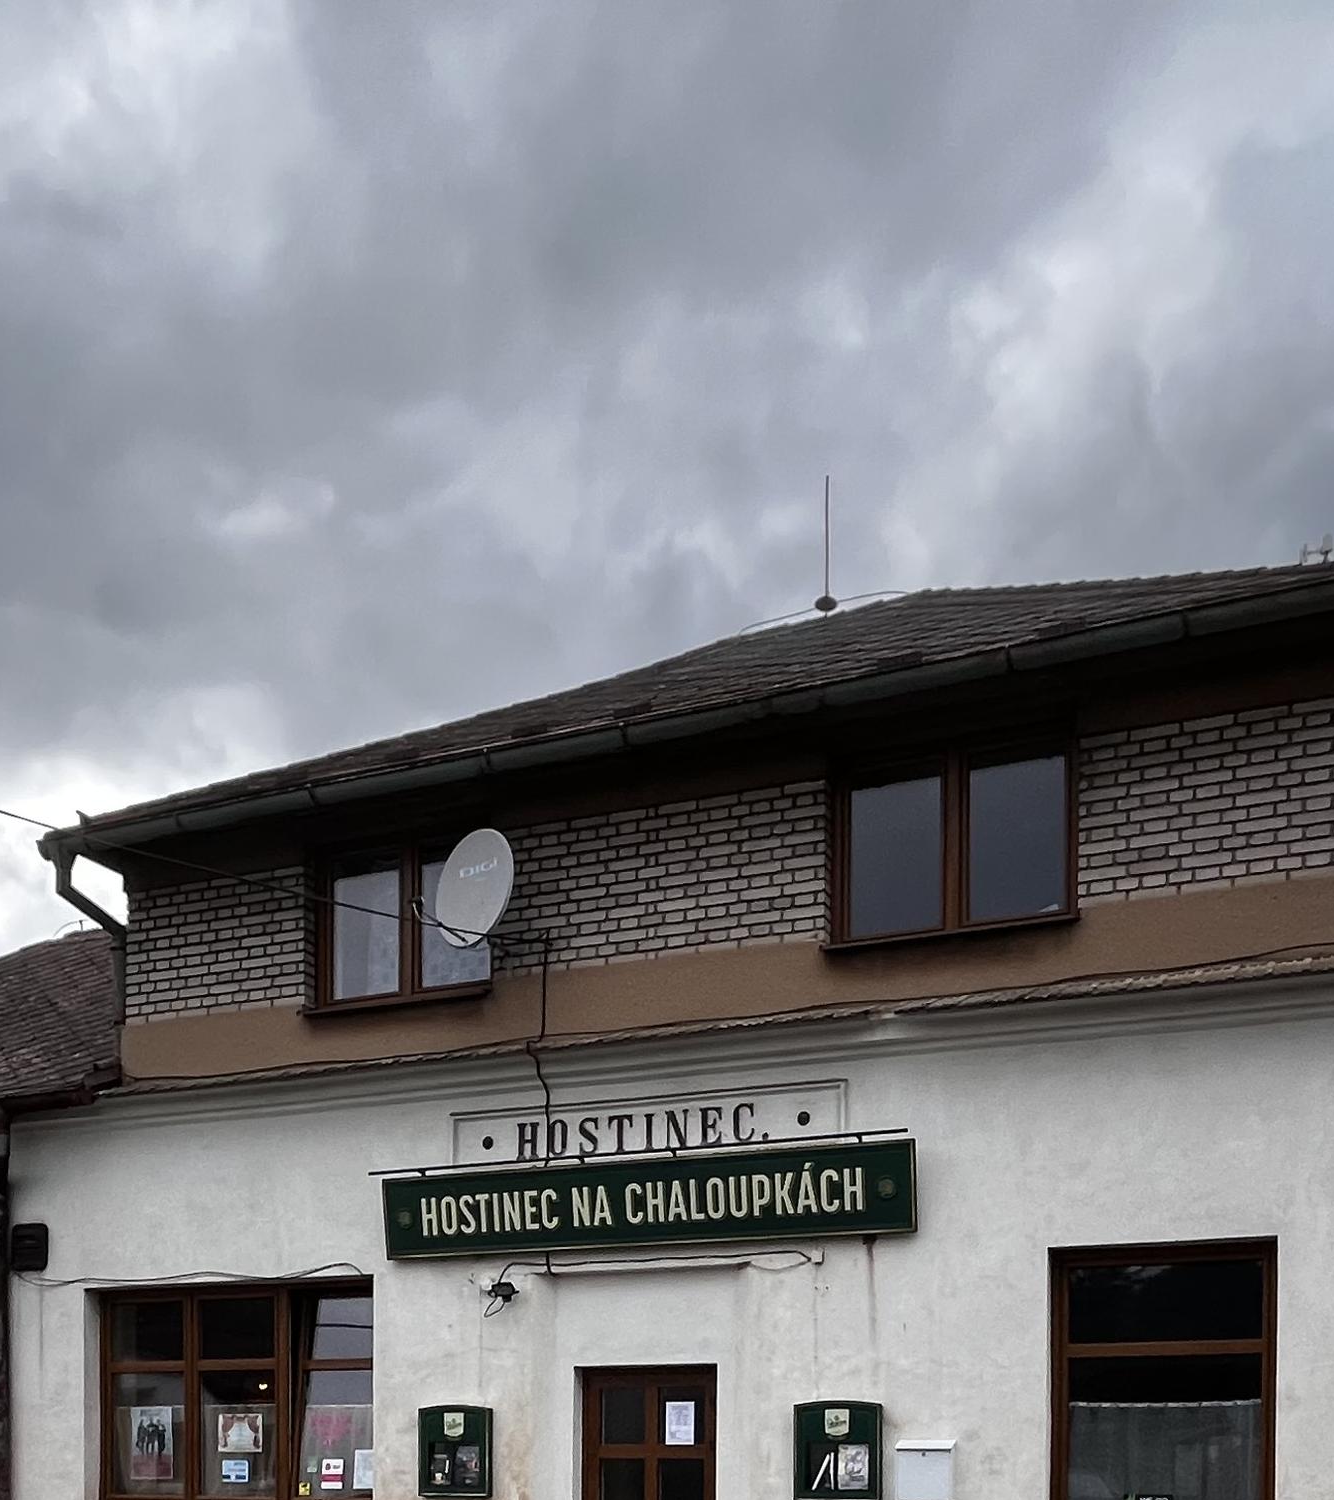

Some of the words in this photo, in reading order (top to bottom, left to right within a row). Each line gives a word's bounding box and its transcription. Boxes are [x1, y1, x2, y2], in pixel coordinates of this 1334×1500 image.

[420, 1188, 560, 1237] HOSTINEC
[572, 1185, 614, 1228] NA
[624, 1162, 865, 1225] CHALOUPKÁCH
